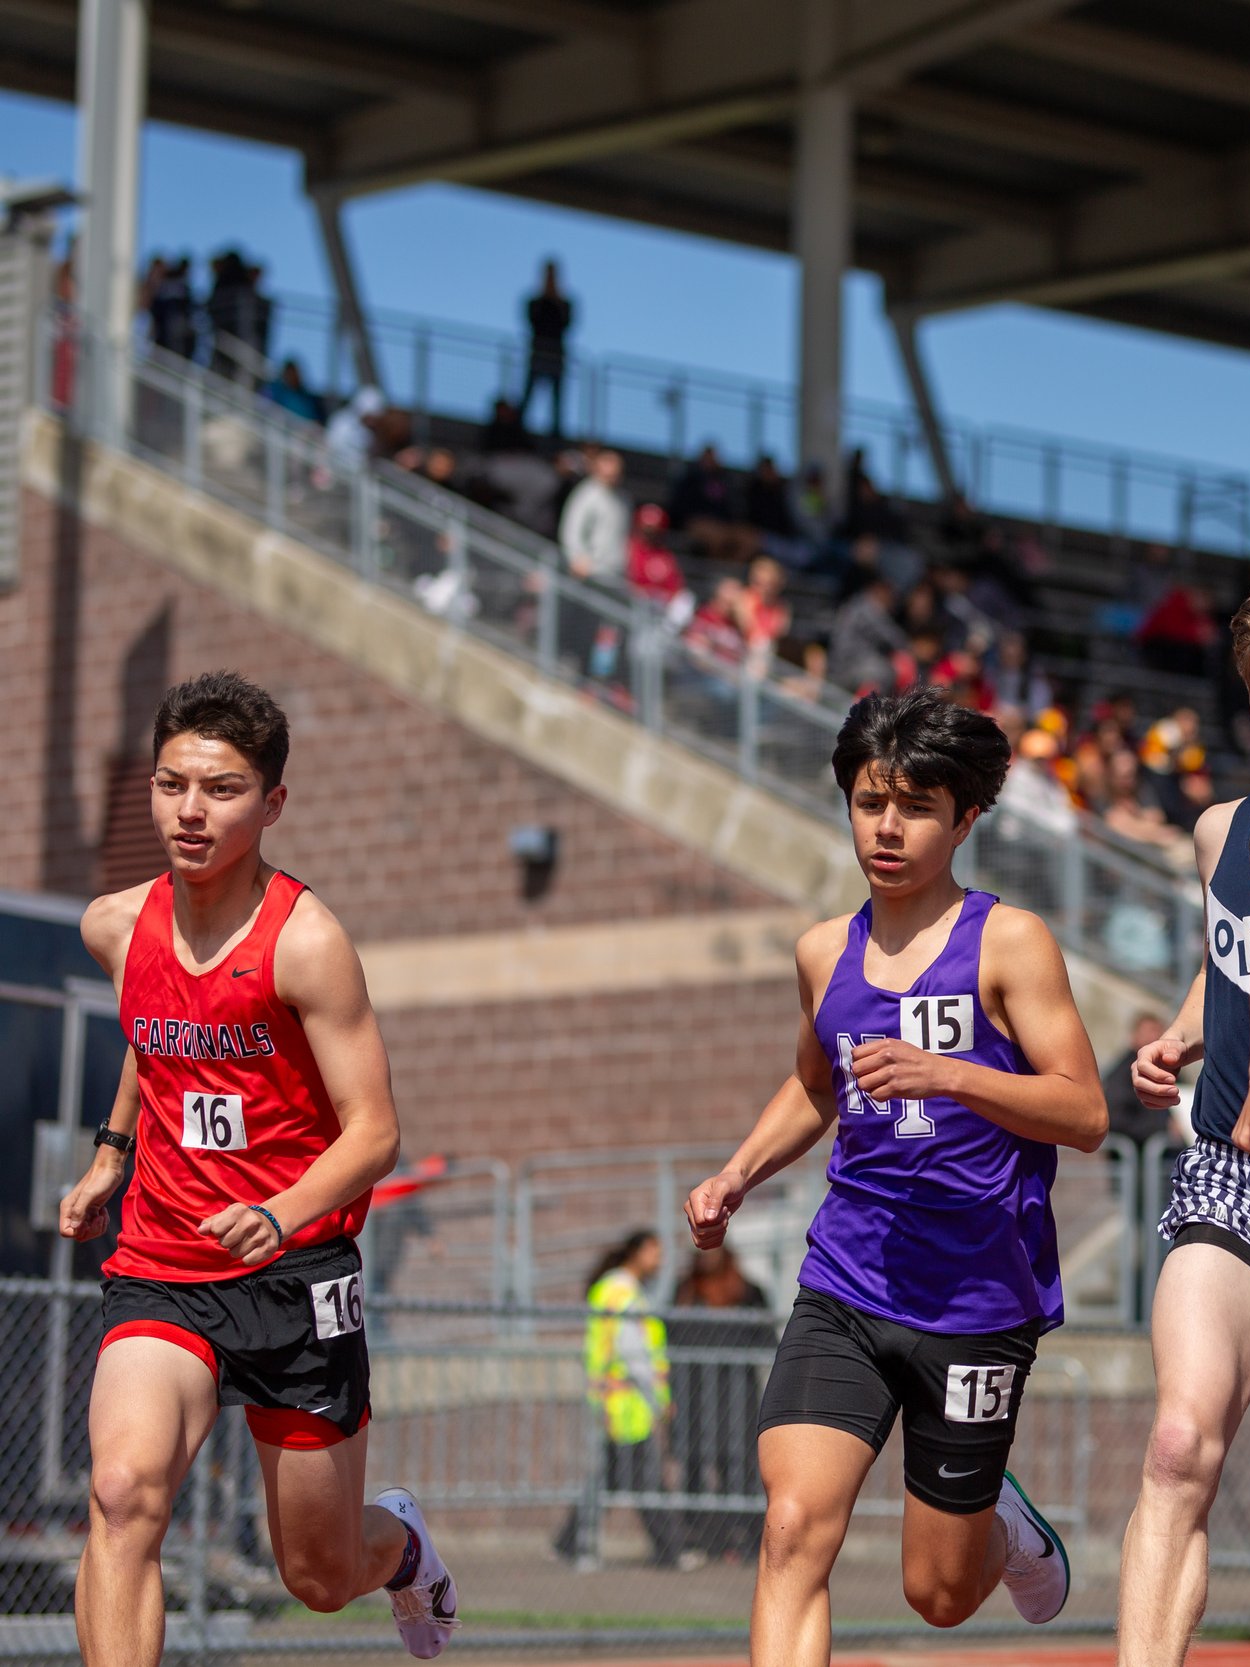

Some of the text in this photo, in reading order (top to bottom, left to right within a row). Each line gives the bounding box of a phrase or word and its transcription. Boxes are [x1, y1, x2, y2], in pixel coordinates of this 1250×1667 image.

[133, 1017, 276, 1061] CARDINALS
[911, 998, 962, 1051] 15
[191, 1096, 232, 1148] 16
[324, 1276, 362, 1332] 16
[960, 1369, 1005, 1419] 15
